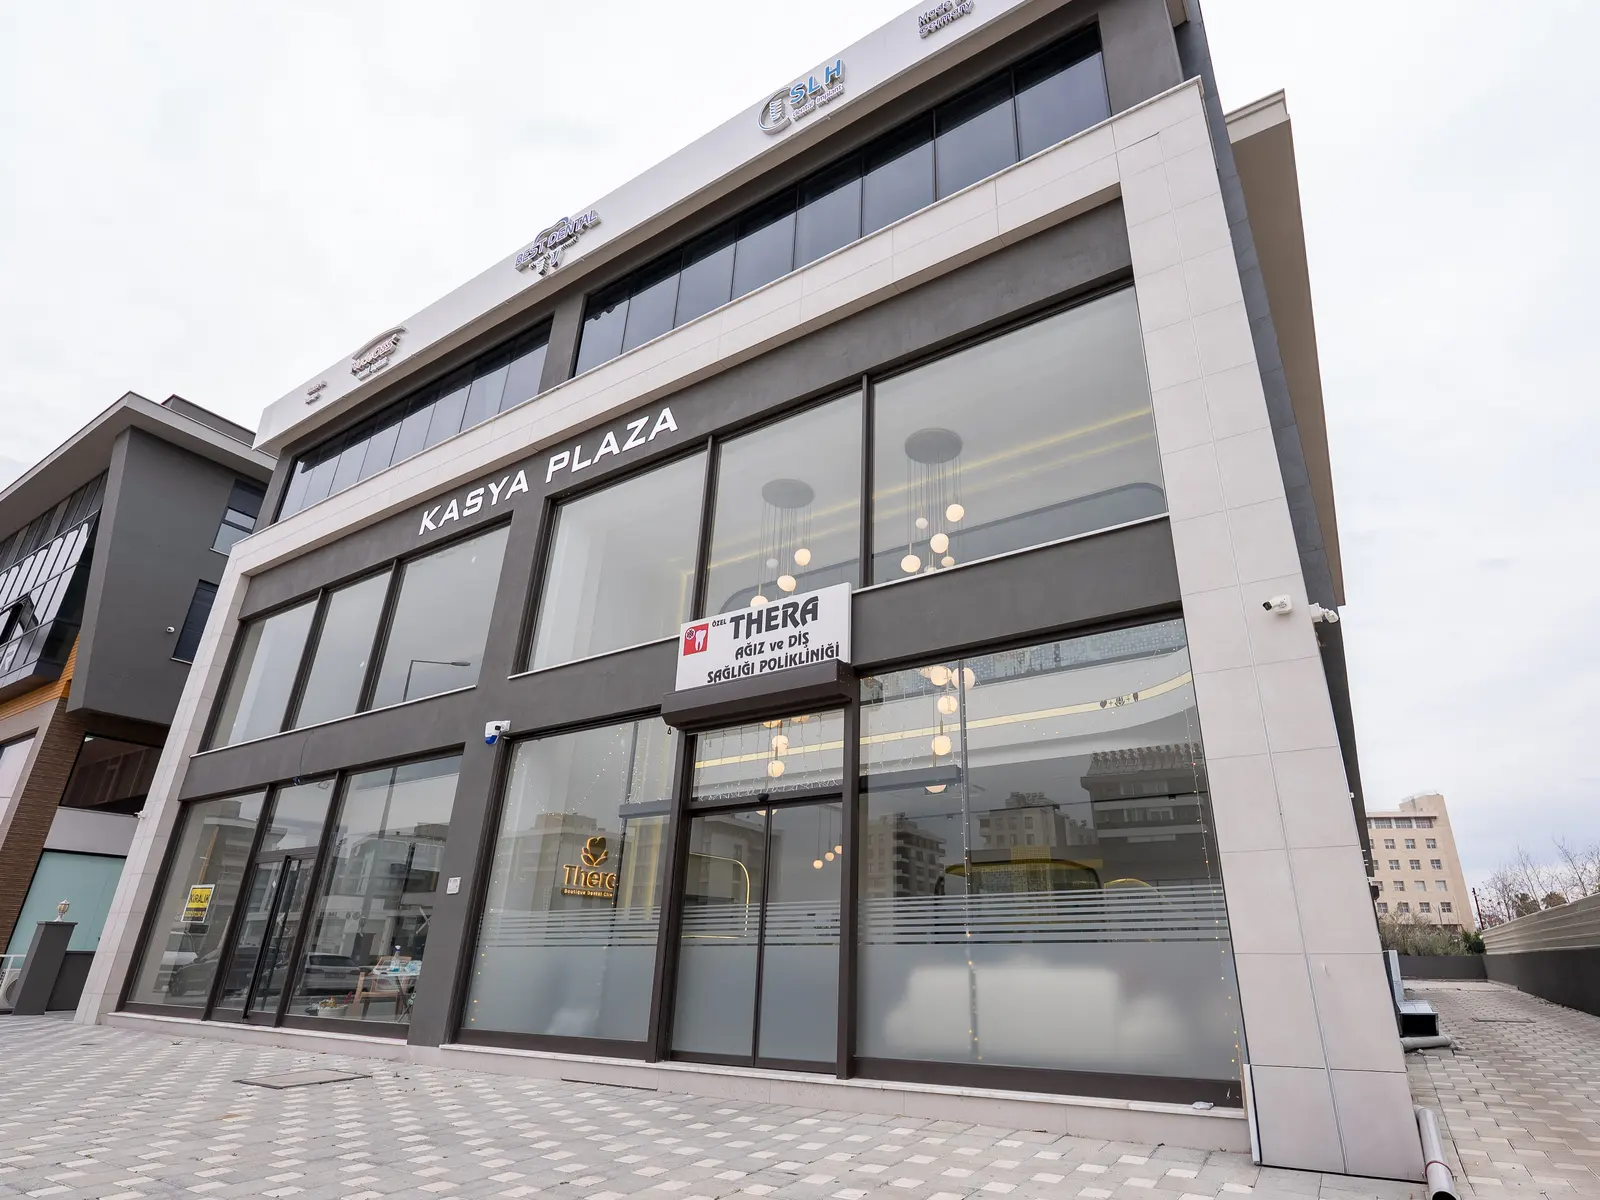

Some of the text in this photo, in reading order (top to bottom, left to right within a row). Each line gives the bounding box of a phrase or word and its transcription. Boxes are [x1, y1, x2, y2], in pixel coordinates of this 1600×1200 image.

[789, 59, 843, 104] SLH
[515, 237, 548, 267] BEST
[547, 209, 598, 247] DENTAL
[418, 406, 679, 536] KASYA PLAZA
[711, 595, 819, 640] ÖZEL THERA
[707, 641, 840, 684] SAĞLIĞI POLİKLİNİĞİ
[735, 630, 810, 661] AĞIZ ve DİŞ
[564, 888, 586, 896] Boutique
